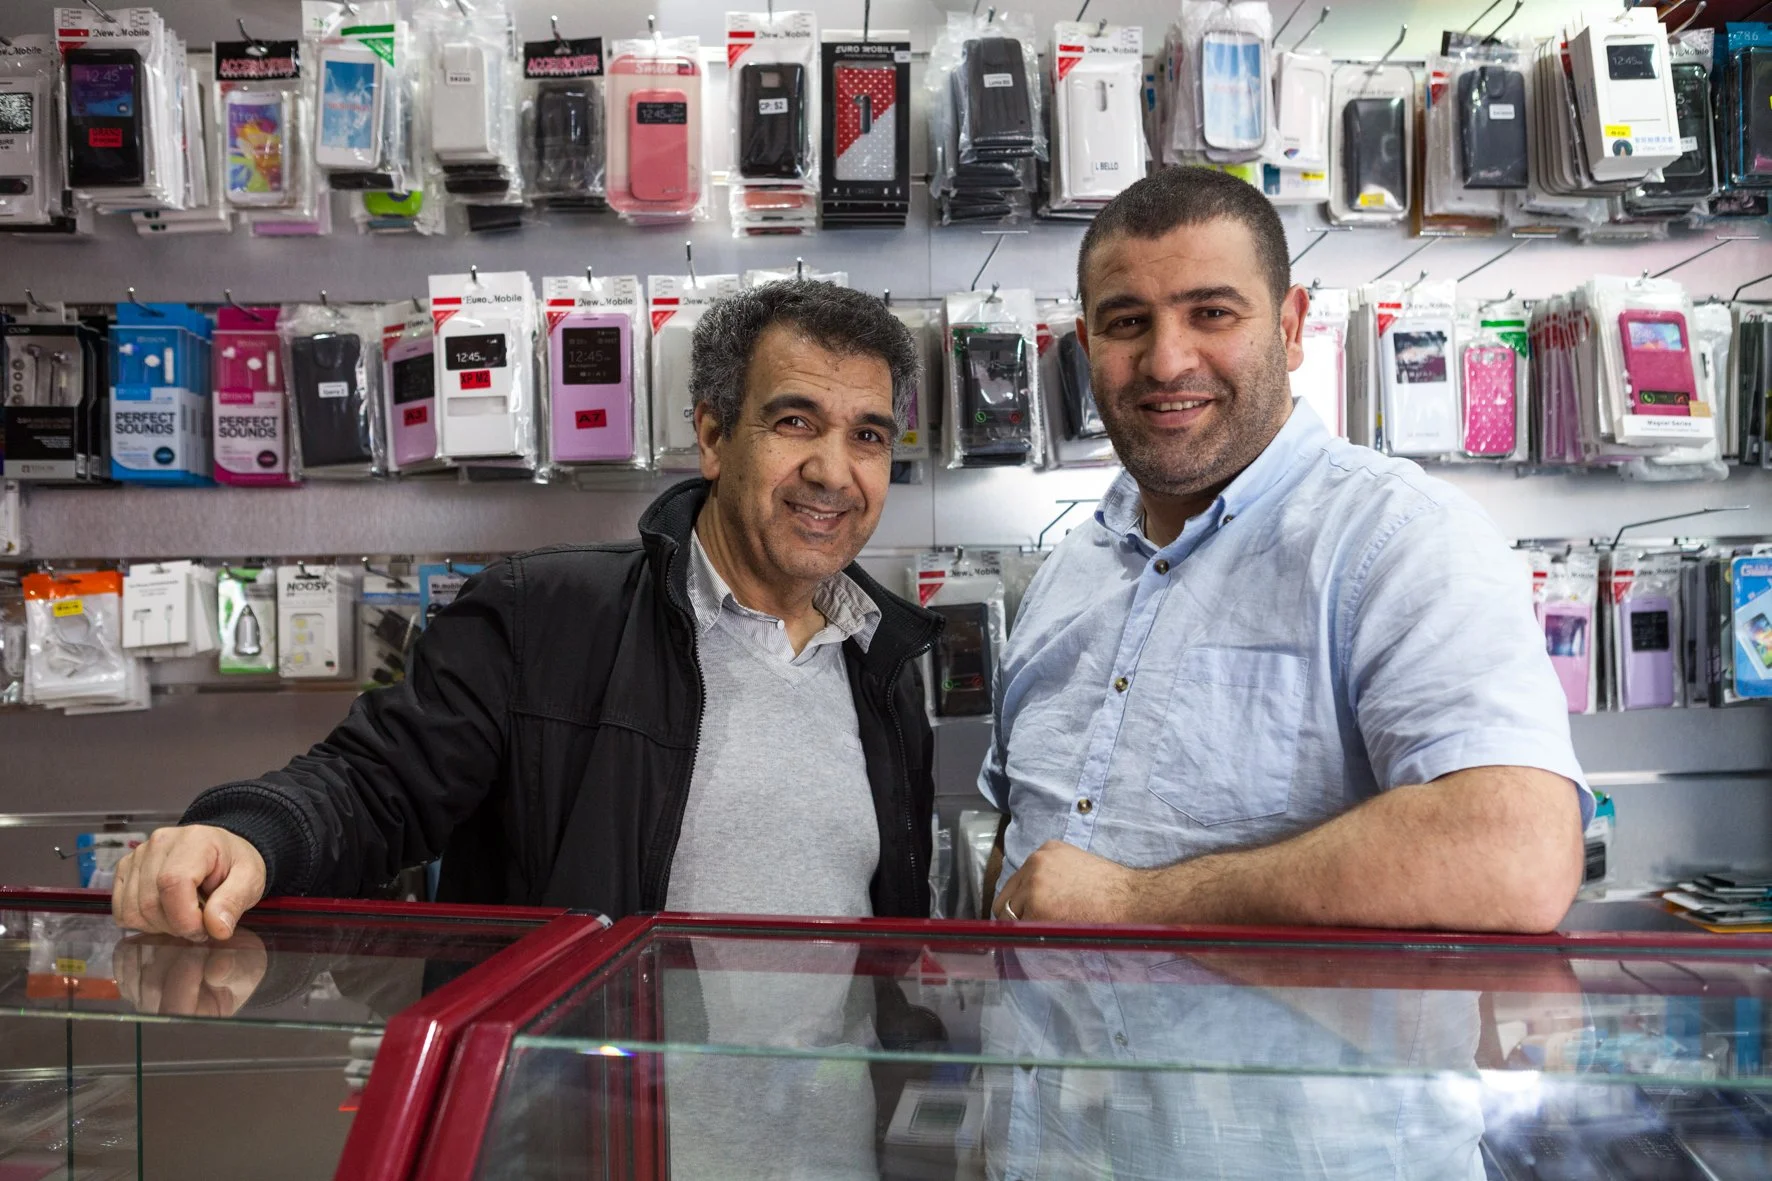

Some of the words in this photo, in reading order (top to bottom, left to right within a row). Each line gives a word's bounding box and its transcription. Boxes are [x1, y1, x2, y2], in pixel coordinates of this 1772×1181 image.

[92, 28, 115, 37] New
[116, 28, 150, 37] Mobile
[779, 30, 811, 38] Mobile
[835, 45, 860, 54] EURO
[862, 45, 896, 53] MOBILE
[488, 295, 522, 303] Mobile
[578, 298, 598, 307] New
[456, 352, 480, 362] 12:45
[461, 373, 473, 382] XP
[475, 372, 489, 381] M2
[115, 412, 176, 424] PERFECT
[219, 416, 277, 427] PERFECT
[579, 413, 601, 423] A7
[115, 424, 174, 435] SOUNDS
[219, 428, 276, 438] SOUNDS
[969, 567, 1000, 576] Mobile
